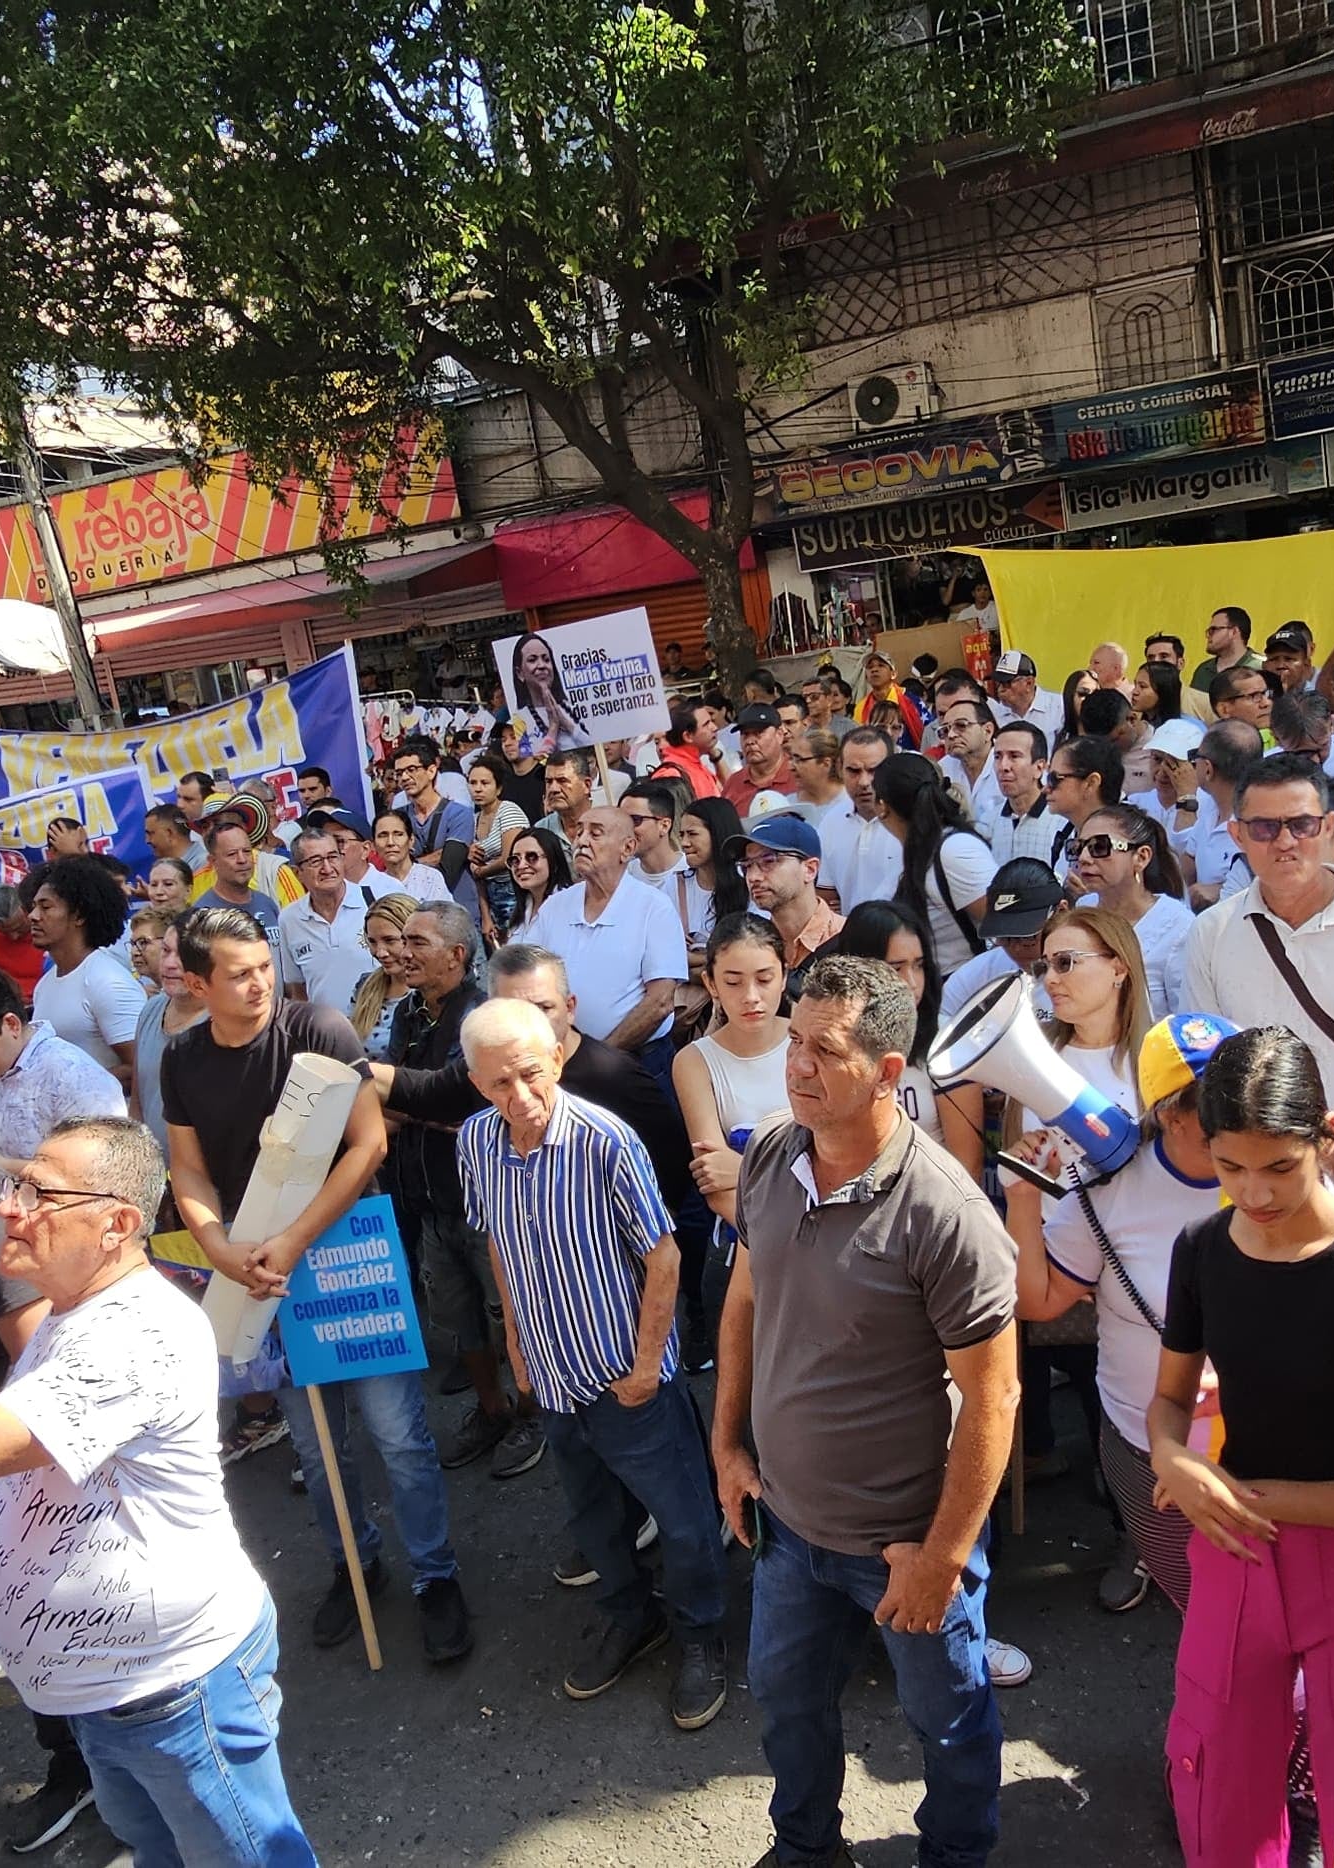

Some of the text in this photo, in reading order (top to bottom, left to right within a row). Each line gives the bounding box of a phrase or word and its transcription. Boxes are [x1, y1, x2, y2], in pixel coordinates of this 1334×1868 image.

[1200, 107, 1258, 142] Coca-Cola
[1077, 382, 1232, 420] CENTRO COMERCIAL
[778, 439, 1000, 504] SEGOVIA
[1068, 484, 1121, 515] Isla
[74, 490, 210, 557] rebaja
[800, 492, 1011, 557] SURTICUEROS
[983, 523, 1036, 543] CÚCUTA
[37, 550, 173, 590] DOGUERIA
[561, 647, 611, 671] Gracias,
[564, 657, 648, 689] María Corina,
[568, 673, 656, 706] por ser el faro
[573, 692, 659, 721] de esperanza.
[350, 1213, 385, 1238] Con
[305, 1237, 390, 1271] Edmundo
[315, 1261, 397, 1294] González
[293, 1287, 401, 1322] comienza la
[313, 1310, 408, 1344] verdadera
[335, 1333, 411, 1365] libertad.
[21, 1488, 121, 1543] Armani
[20, 1598, 135, 1648] Armani
